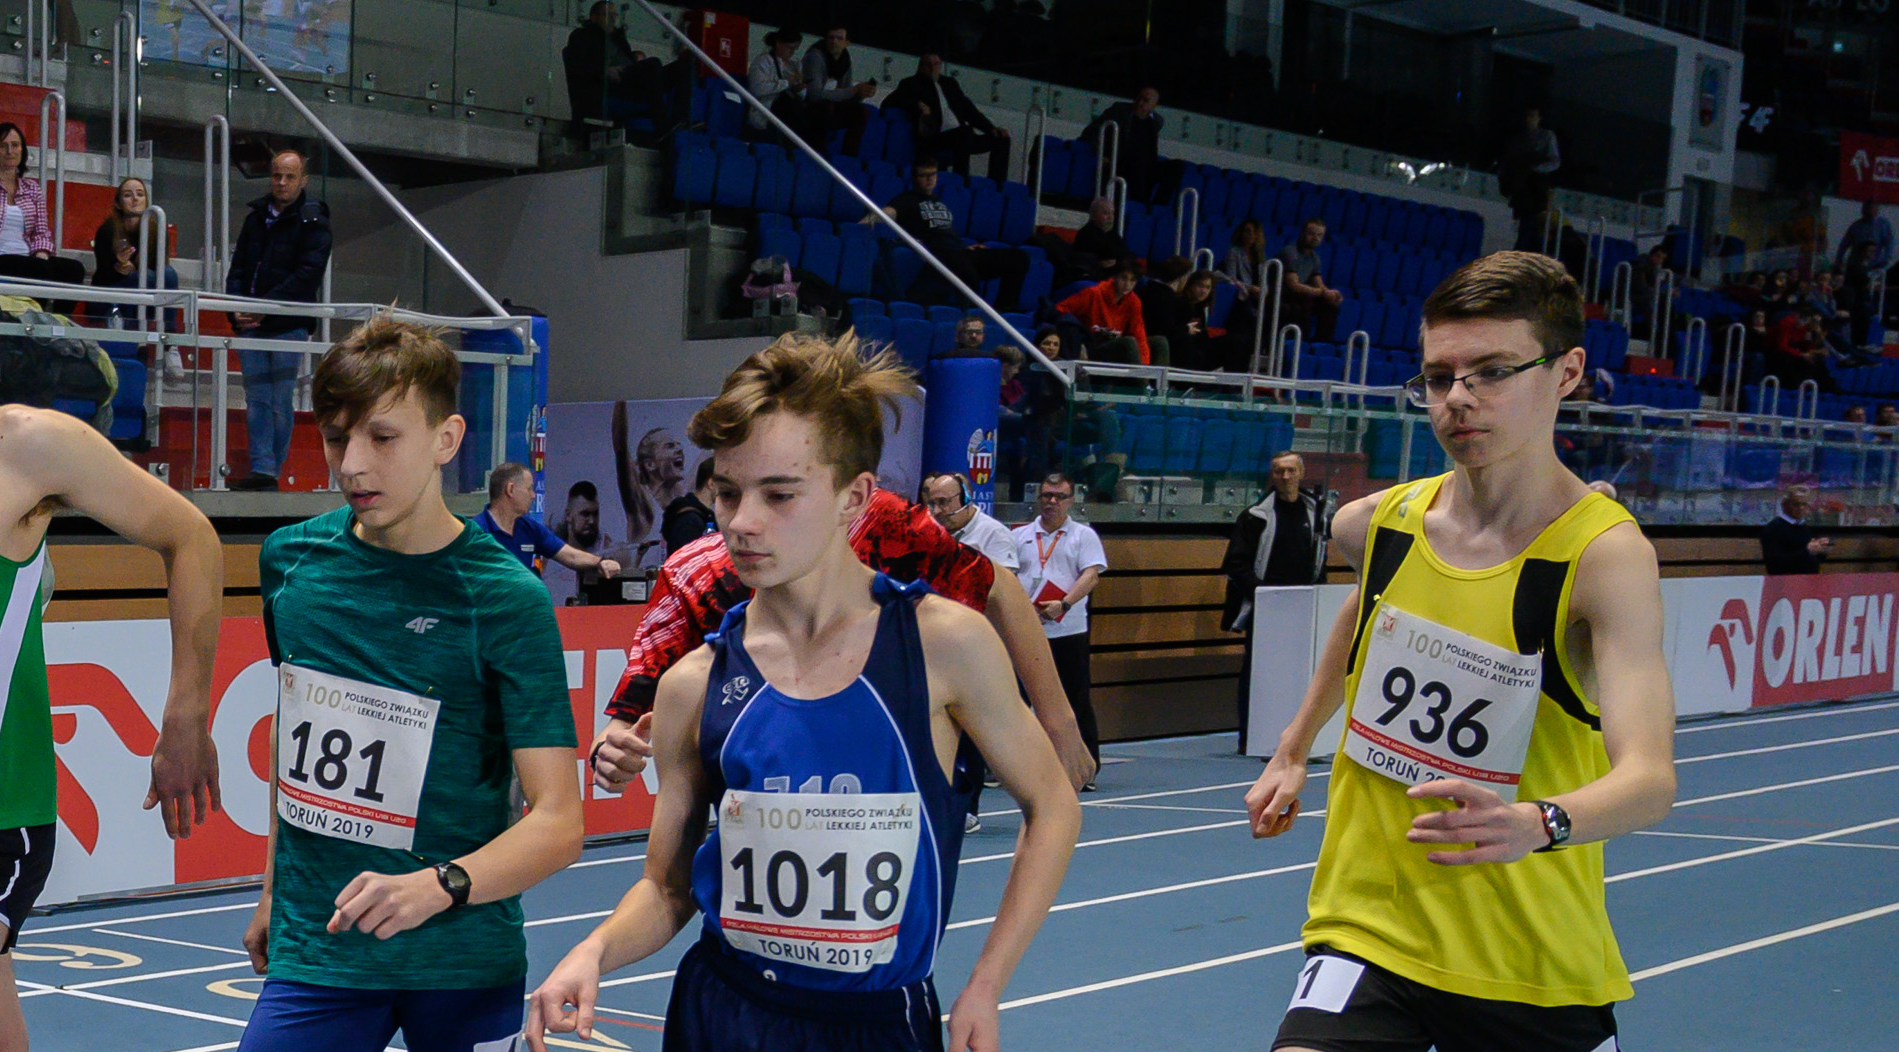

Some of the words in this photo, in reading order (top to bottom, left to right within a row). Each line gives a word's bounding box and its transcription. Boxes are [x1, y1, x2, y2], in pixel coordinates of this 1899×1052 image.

[405, 616, 440, 634] 4F
[1762, 593, 1894, 689] ORLEN
[1406, 630, 1443, 658] 100
[1445, 643, 1492, 667] POLSKIEGO
[1492, 661, 1537, 677] ZWIĄZKU
[1457, 660, 1489, 678] LEKKIEJ
[1490, 673, 1534, 688] ATLETYKI
[305, 683, 342, 709] 100
[345, 691, 388, 709] POLSKIEGO
[390, 703, 429, 719] ZWIĄZKU
[357, 706, 386, 721] LEKKIEJ
[388, 714, 427, 730] ATLETYKI
[1374, 666, 1493, 758] 936
[288, 721, 386, 803] 181
[1365, 747, 1420, 783] TORUŃ
[300, 792, 347, 811] MISTRZOSTWA
[757, 808, 802, 830] 100
[805, 808, 866, 818] POLSKIEGO
[868, 808, 913, 820] ZWIĄZKU
[286, 801, 328, 829] TORUŃ
[332, 818, 374, 839] 2019
[826, 821, 867, 831] LEKKIEJ
[869, 821, 913, 830] ATLETYKI
[730, 848, 903, 921] 1018
[758, 939, 820, 962] TORUŃ
[826, 948, 873, 966] 2019
[1299, 959, 1324, 1000] 1
